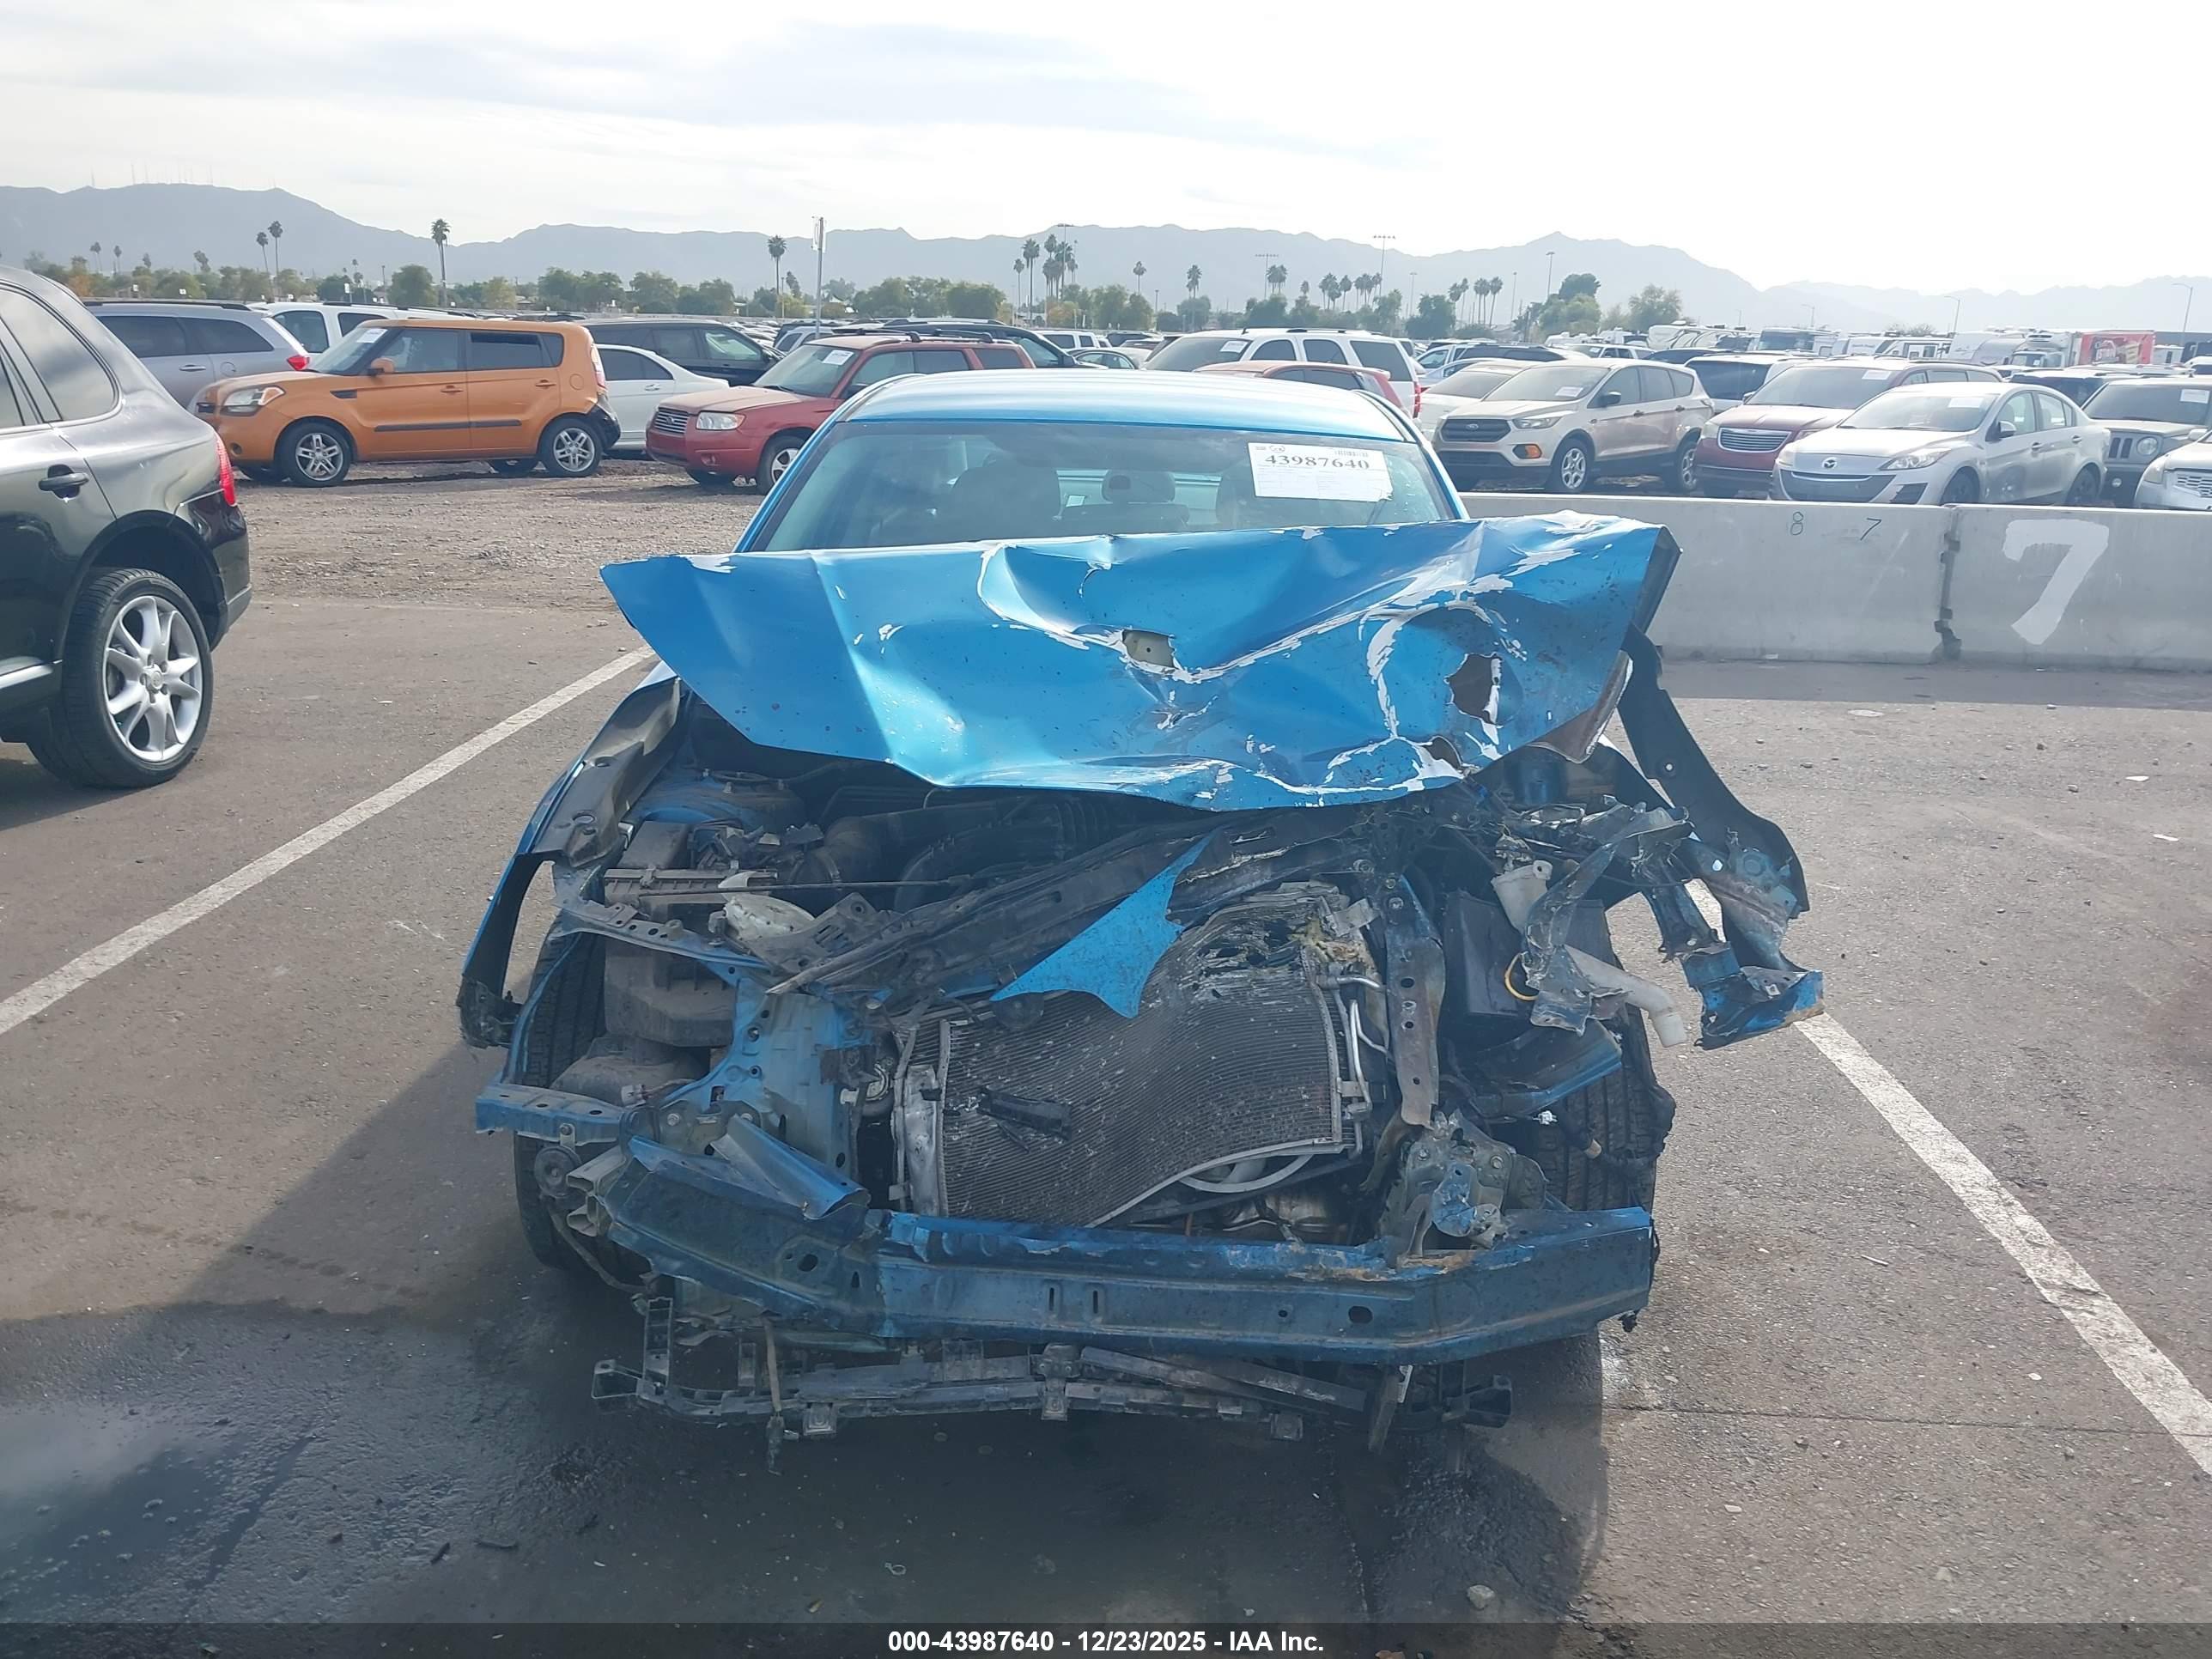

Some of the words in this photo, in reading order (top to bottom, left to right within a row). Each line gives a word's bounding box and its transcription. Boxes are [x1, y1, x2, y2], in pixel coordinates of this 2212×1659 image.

[1264, 454, 1370, 470] 43987640
[1790, 511, 1804, 536] 8
[1859, 517, 1882, 541] 7
[2002, 519, 2110, 645] 7
